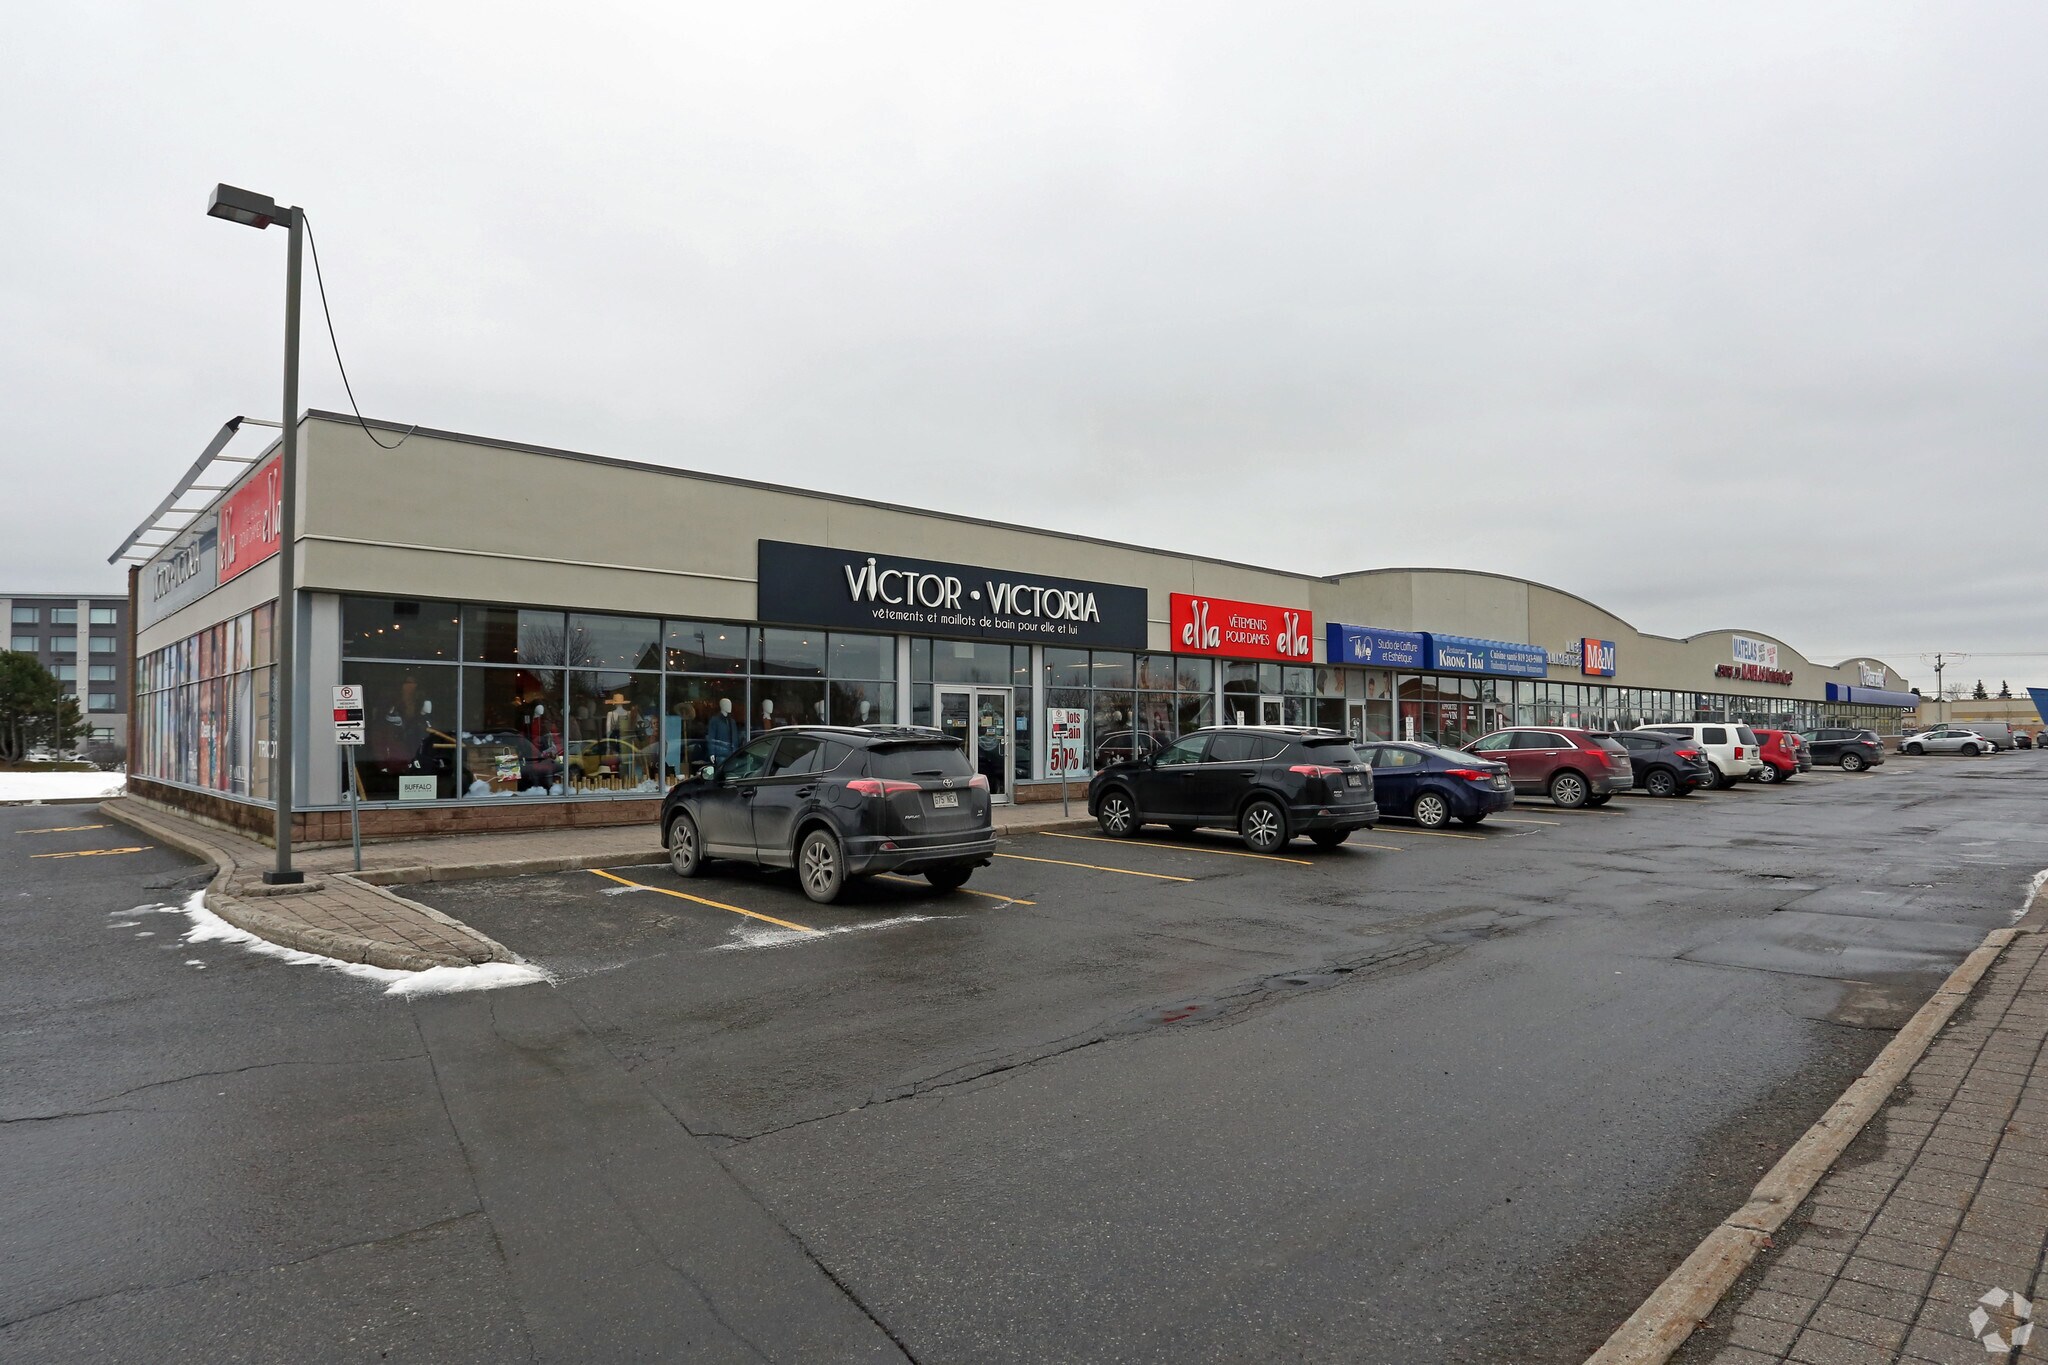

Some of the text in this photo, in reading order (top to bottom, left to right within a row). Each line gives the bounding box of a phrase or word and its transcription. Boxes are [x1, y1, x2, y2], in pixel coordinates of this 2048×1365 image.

[844, 557, 1100, 622] VICTOR VICTORIA
[872, 608, 1078, 635] vêtements et maillots de bain pour elle et lui
[1182, 600, 1221, 649] ella
[1228, 613, 1268, 631] VÊTEMENTS
[1226, 631, 1270, 646] POUR DAMES
[1276, 611, 1309, 657] ella
[1377, 638, 1393, 650] Studio
[1393, 640, 1400, 651] de
[1382, 652, 1388, 661] et
[1586, 644, 1614, 671] M&M
[1733, 638, 1757, 661] MATELAS
[1064, 725, 1081, 739] ain
[1050, 747, 1079, 771] 50%
[404, 783, 432, 791] BUFFALO
